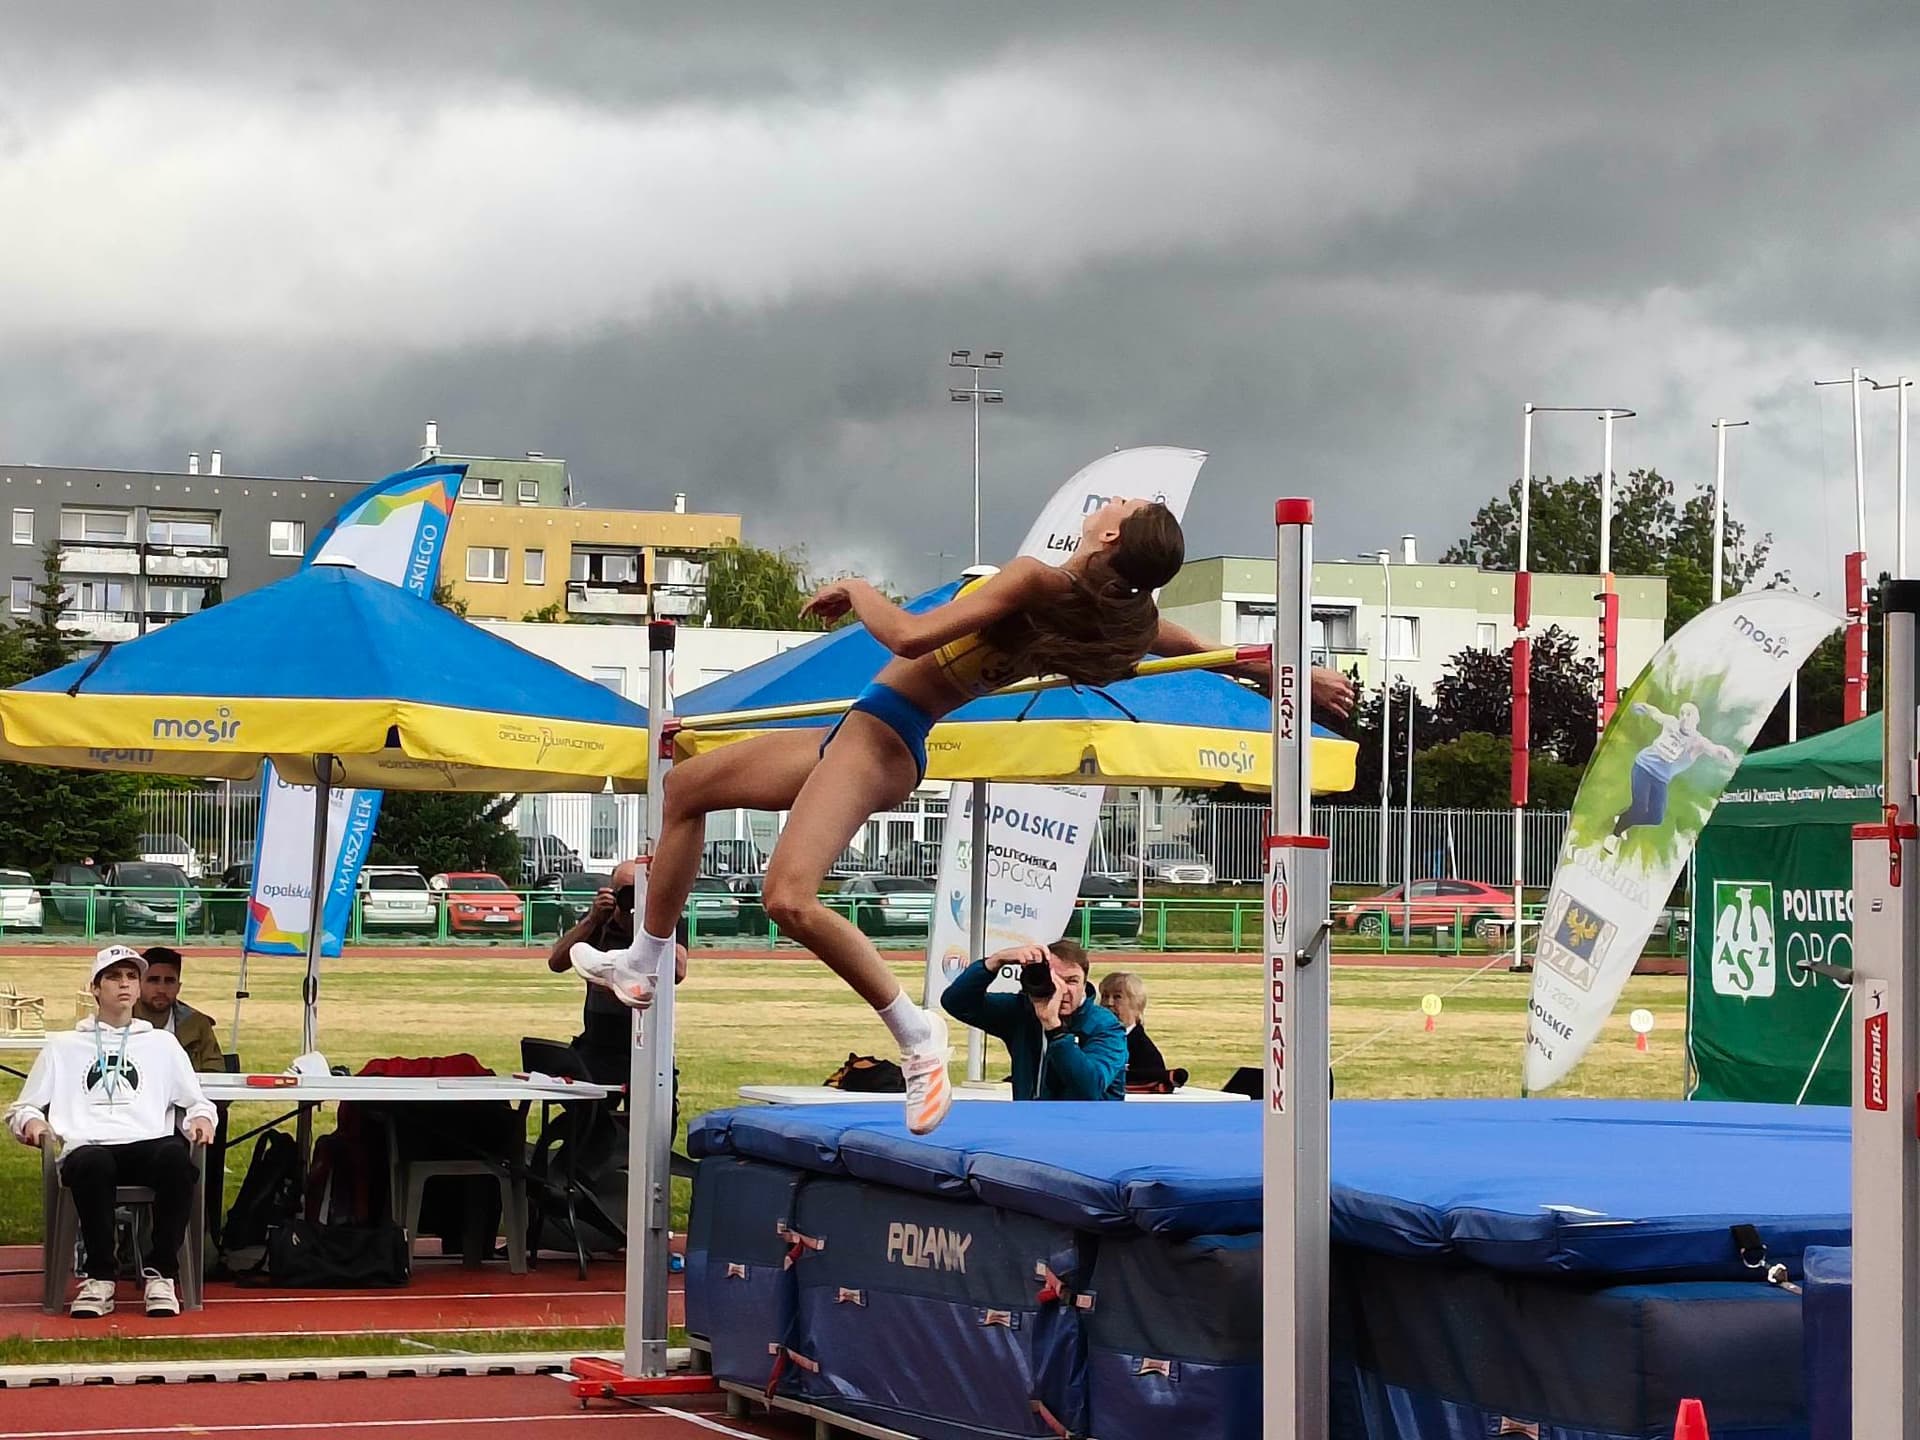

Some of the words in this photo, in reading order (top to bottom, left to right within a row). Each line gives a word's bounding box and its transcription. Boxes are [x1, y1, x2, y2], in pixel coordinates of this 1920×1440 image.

[409, 524, 438, 597] SKIEGO
[1734, 614, 1790, 659] mosir
[153, 707, 241, 743] mosir
[1281, 666, 1294, 740] POLANIK
[1198, 740, 1255, 774] mosir
[1272, 957, 1285, 1112] POLANIK
[1870, 1022, 1884, 1105] polanik
